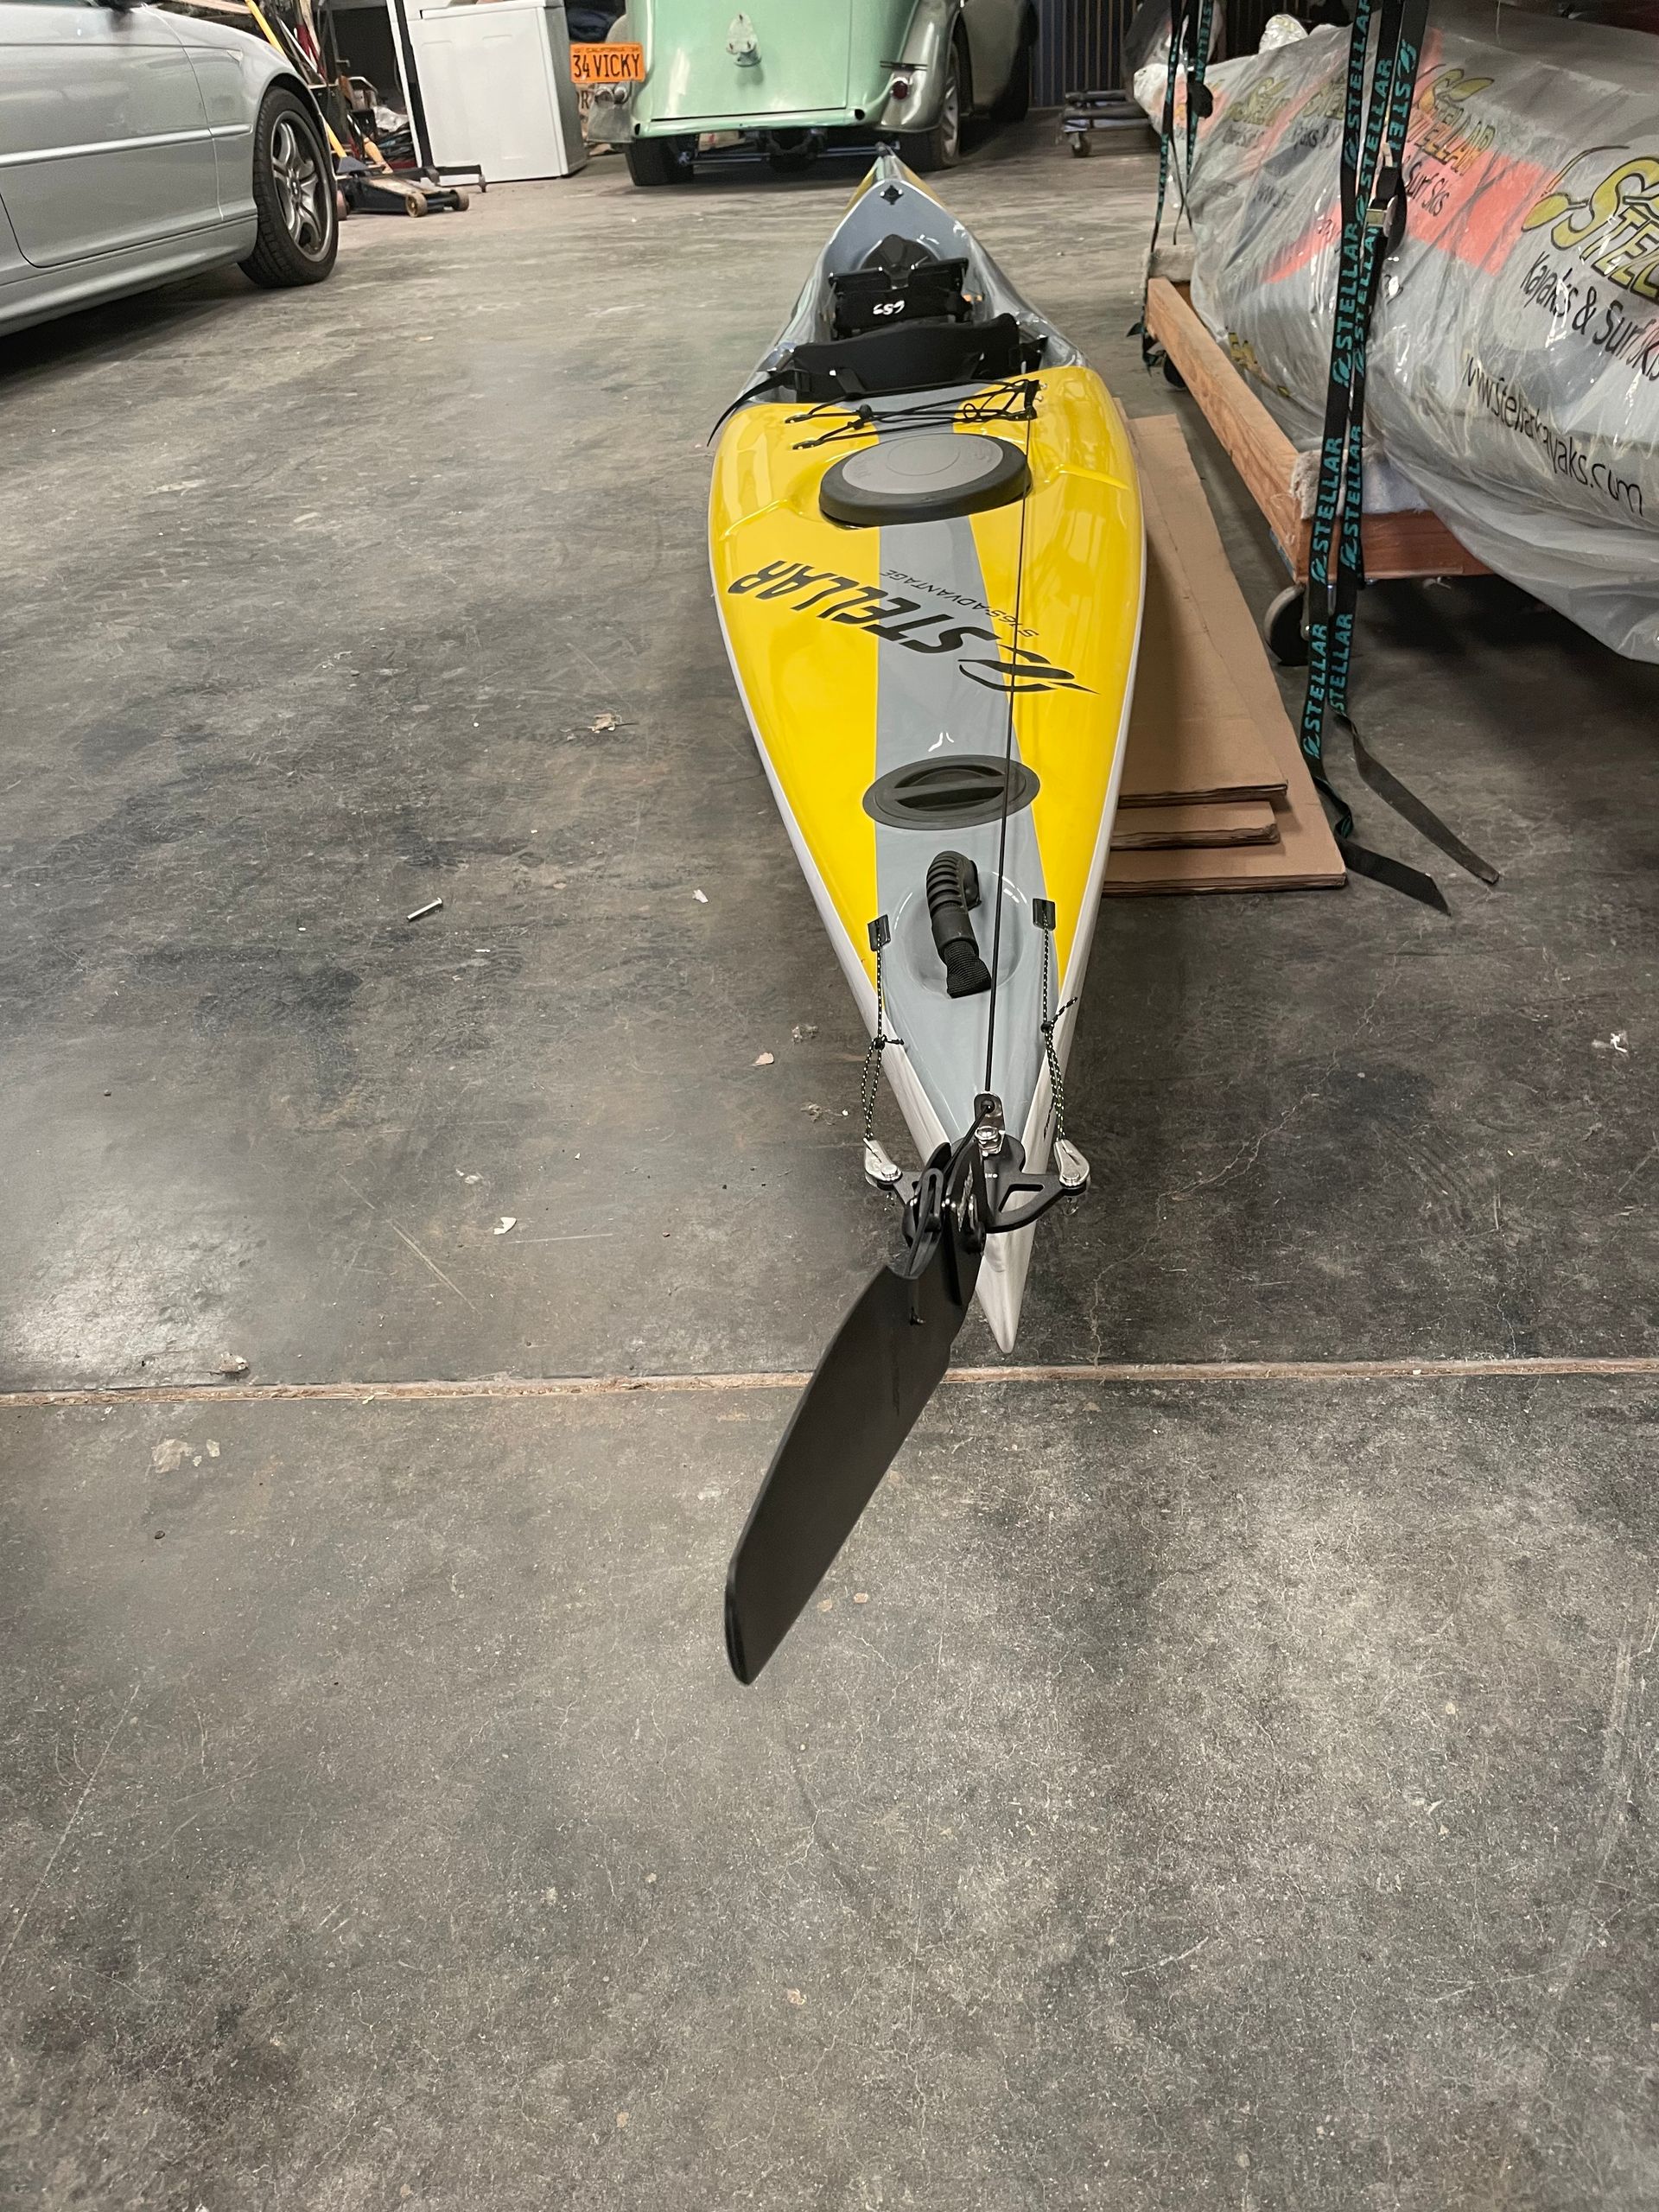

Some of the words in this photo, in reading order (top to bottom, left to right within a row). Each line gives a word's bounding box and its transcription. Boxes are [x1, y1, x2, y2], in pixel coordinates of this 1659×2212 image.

[573, 54, 590, 78] 34
[593, 54, 639, 78] VICKY
[1360, 60, 1393, 188] STELLAR
[1336, 222, 1359, 350] STELLAR
[1572, 285, 1597, 335] &
[1592, 300, 1656, 359] Surf
[1313, 437, 1343, 553] STELLAR
[1344, 425, 1362, 537] STELLAR
[728, 560, 1002, 654] STELLAR
[1304, 623, 1328, 733] STELLAR
[1328, 613, 1354, 713] STELLAR
